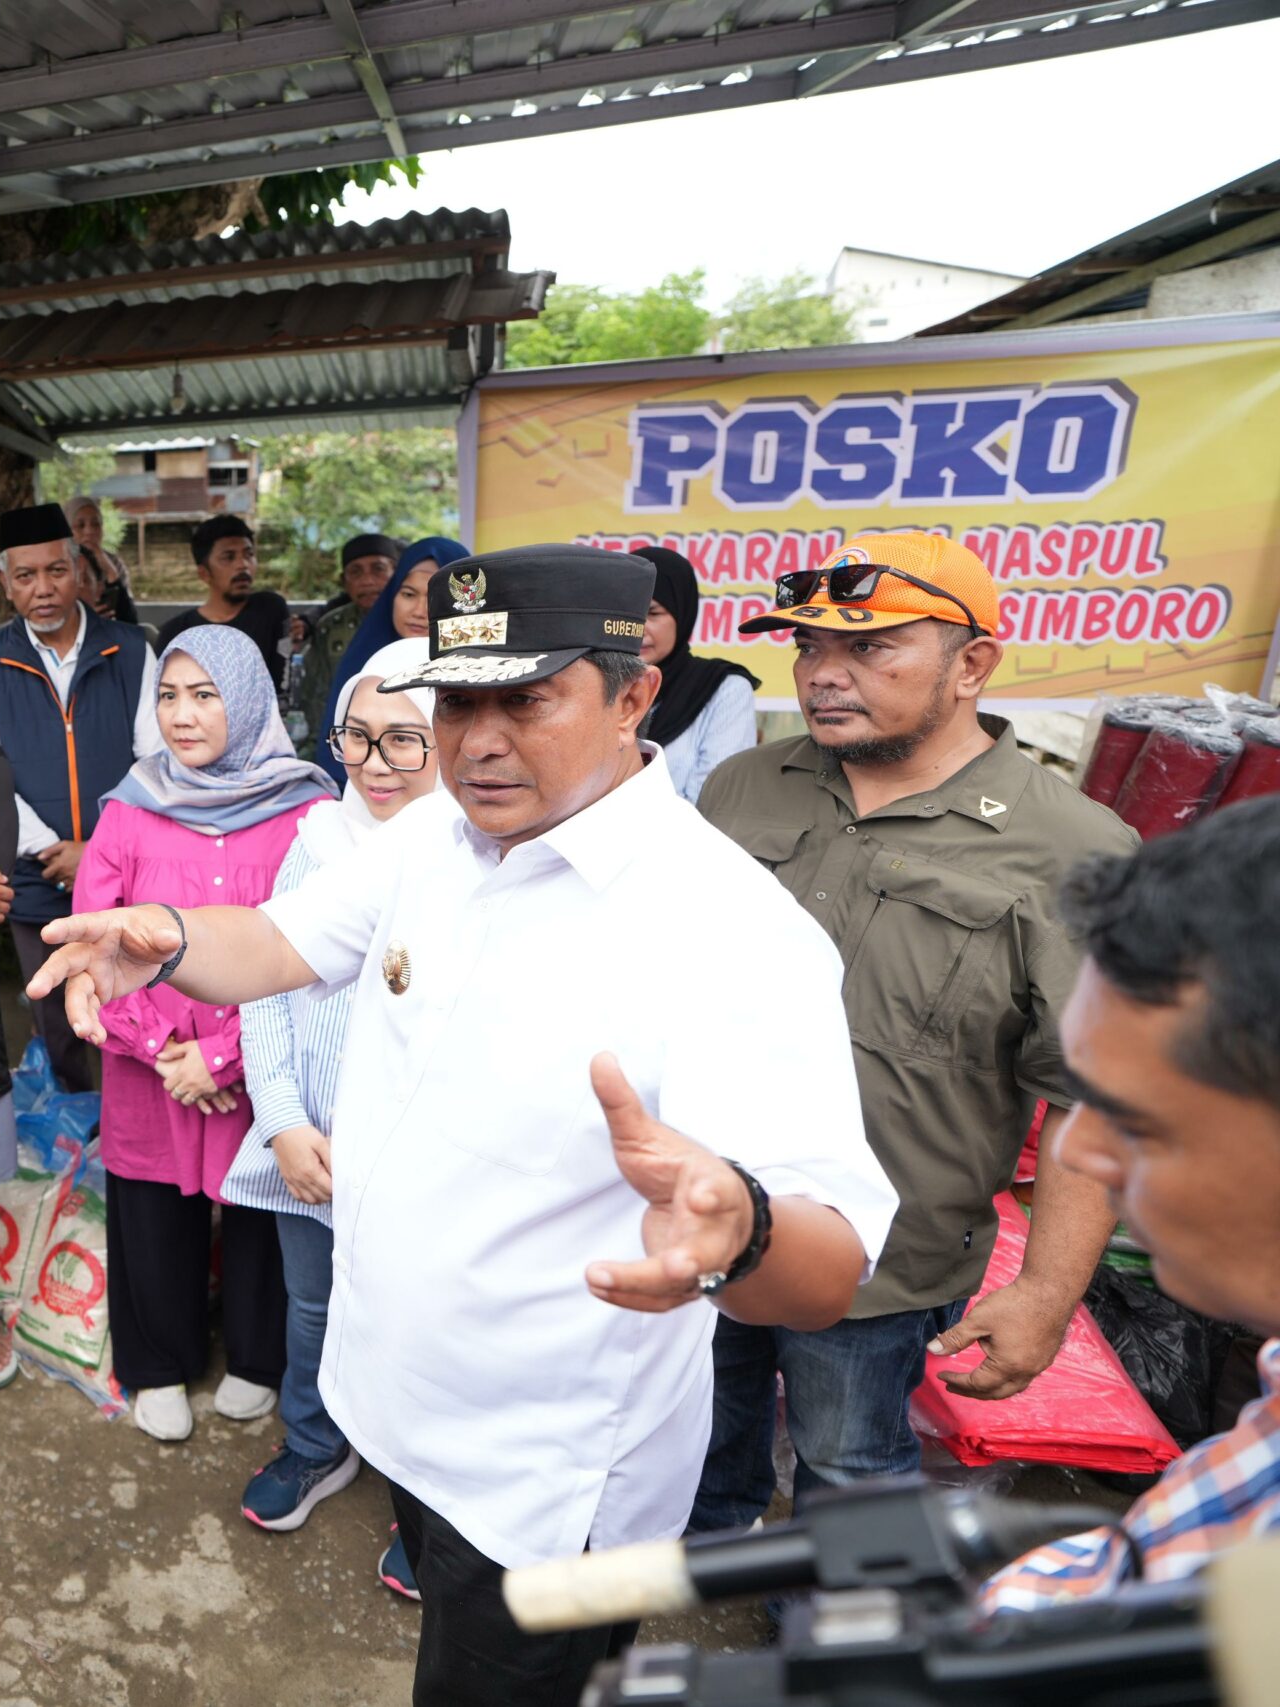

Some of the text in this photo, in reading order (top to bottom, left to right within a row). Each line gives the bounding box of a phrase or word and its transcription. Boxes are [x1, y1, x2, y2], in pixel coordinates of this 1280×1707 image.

[624, 384, 1132, 513] POSKO
[962, 522, 1164, 582] MASPUL
[995, 587, 1229, 645] SIMBORO
